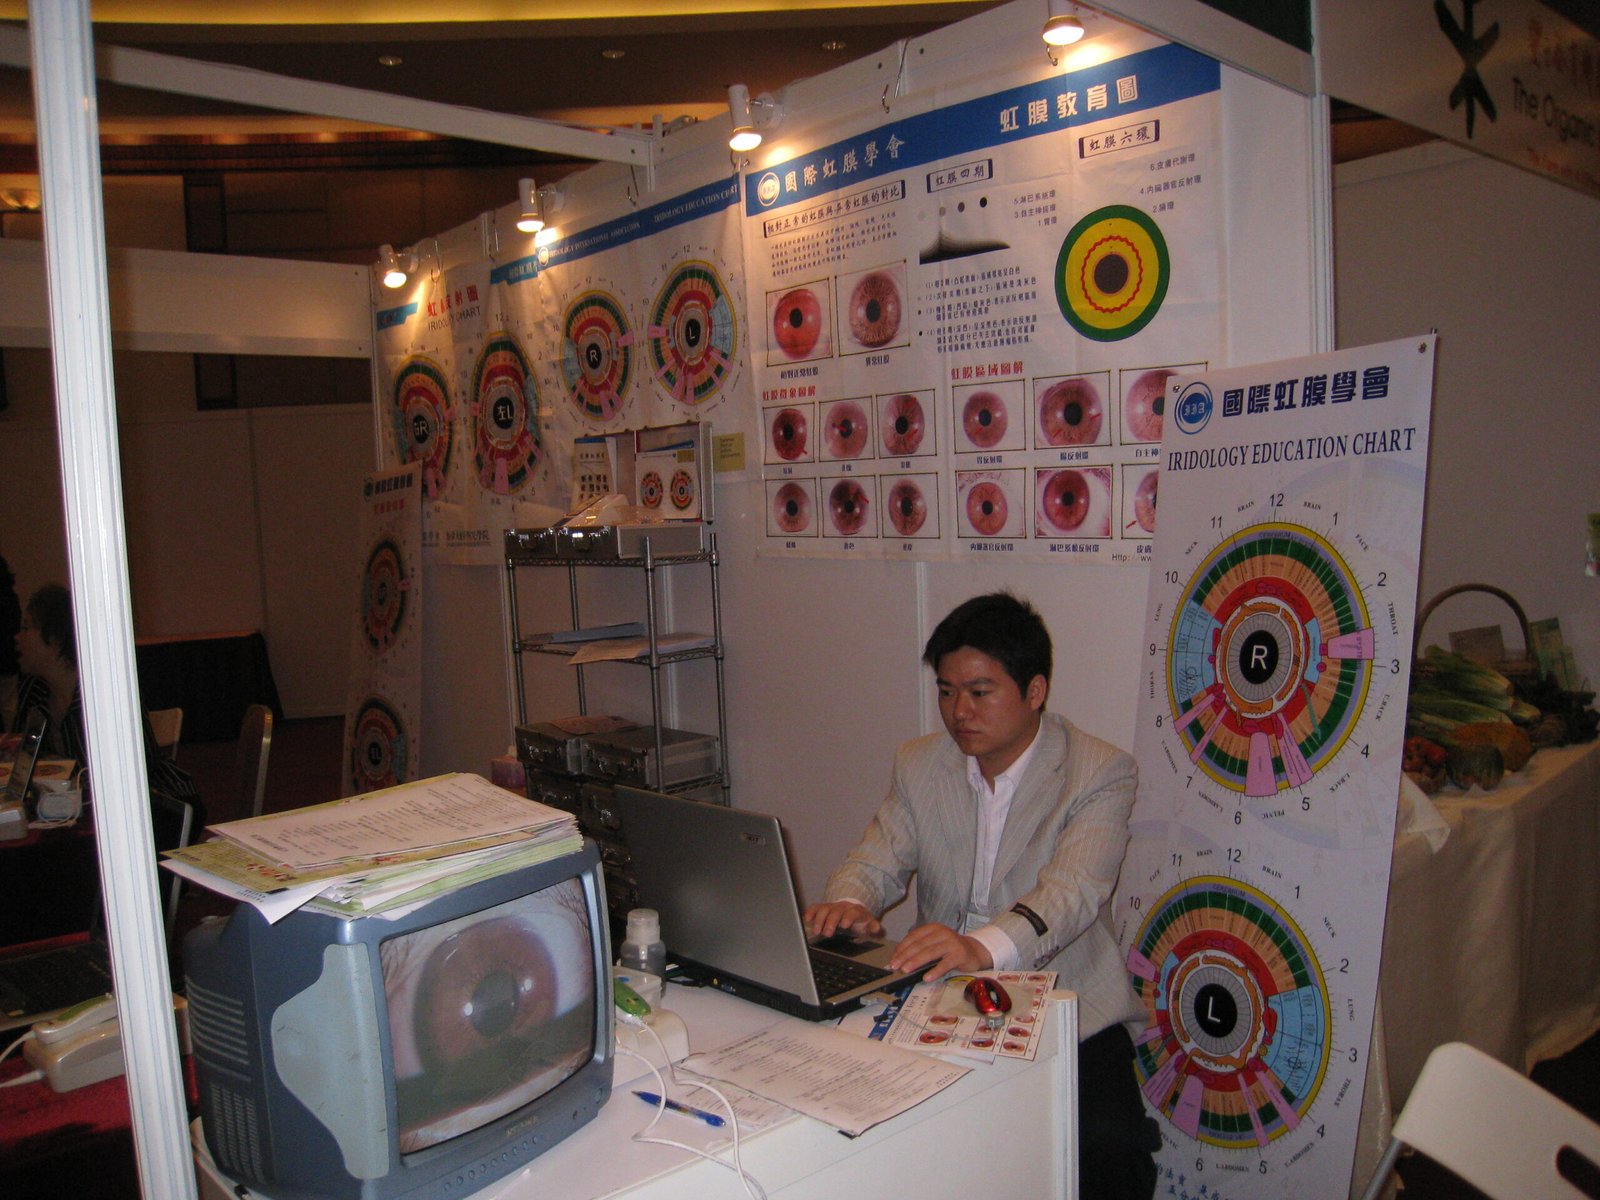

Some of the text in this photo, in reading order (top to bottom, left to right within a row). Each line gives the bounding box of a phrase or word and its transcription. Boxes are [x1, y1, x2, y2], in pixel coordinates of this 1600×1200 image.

[1000, 75, 1138, 133] 虹膜教育圖
[1089, 127, 1151, 151] 虹膜六環
[784, 133, 905, 192] 國際虹膜學會
[936, 165, 985, 186] 虹膜四期
[589, 349, 598, 361] R
[1222, 365, 1390, 417] 國際虹膜學會
[1167, 427, 1416, 471] IRIDOLOGY EDUCATION CHART
[1269, 493, 1285, 508] 12
[1210, 515, 1223, 529] 11
[1332, 512, 1339, 526] 1
[1165, 570, 1179, 584] 10
[1377, 572, 1387, 587] 2
[1387, 602, 1398, 636] THROAT
[1150, 644, 1156, 656] 9
[1250, 644, 1268, 670] R
[1390, 658, 1400, 674] 3
[1155, 715, 1163, 727] 8
[1361, 744, 1370, 758] 4
[1185, 776, 1192, 788] 7
[1301, 797, 1310, 811] 5
[1234, 811, 1242, 825] 6
[1172, 853, 1183, 867] 11
[1226, 848, 1242, 863] 12
[1294, 885, 1301, 899] 1
[1129, 896, 1140, 910] 10
[1339, 958, 1349, 973] 2
[1207, 995, 1221, 1022] L
[1348, 1048, 1358, 1063] 3
[1316, 1123, 1326, 1139] 4
[1195, 1157, 1204, 1172] 6
[1258, 1160, 1268, 1175] 5
